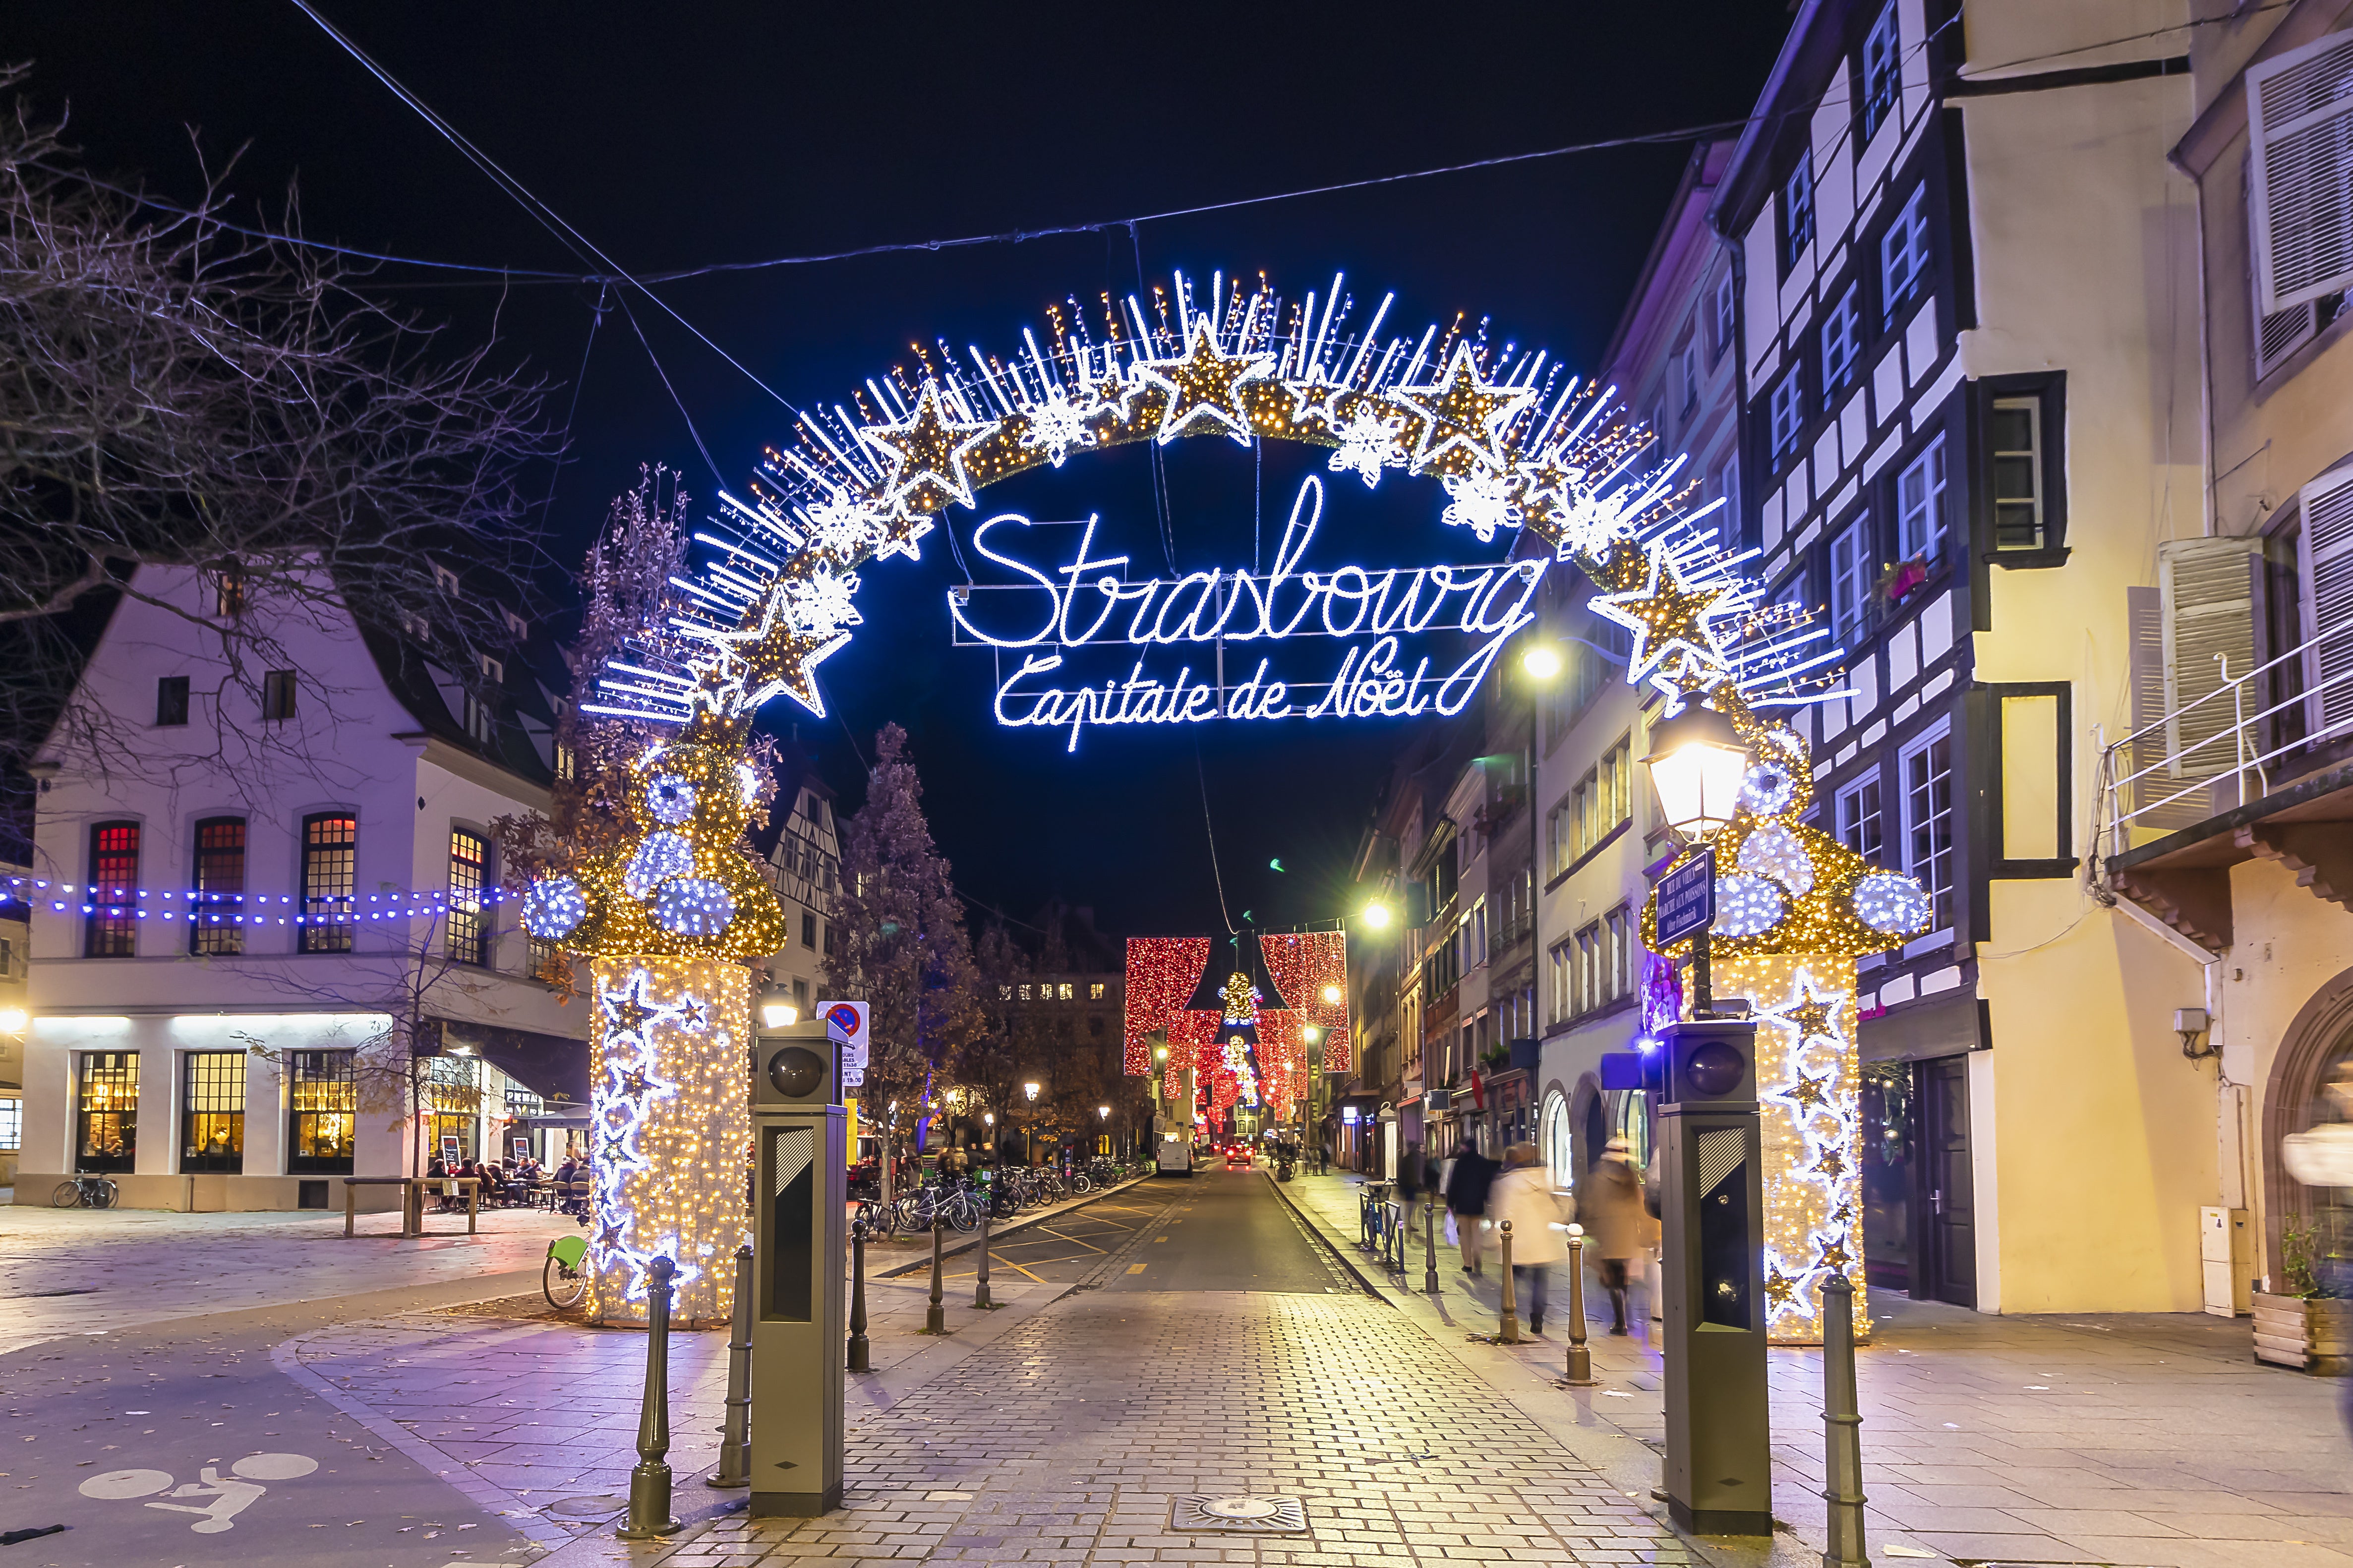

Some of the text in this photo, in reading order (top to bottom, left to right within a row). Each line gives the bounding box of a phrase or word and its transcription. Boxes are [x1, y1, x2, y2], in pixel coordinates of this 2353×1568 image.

[948, 474, 1551, 716] Strasbourg
[994, 635, 1429, 753] Capitale de Noël
